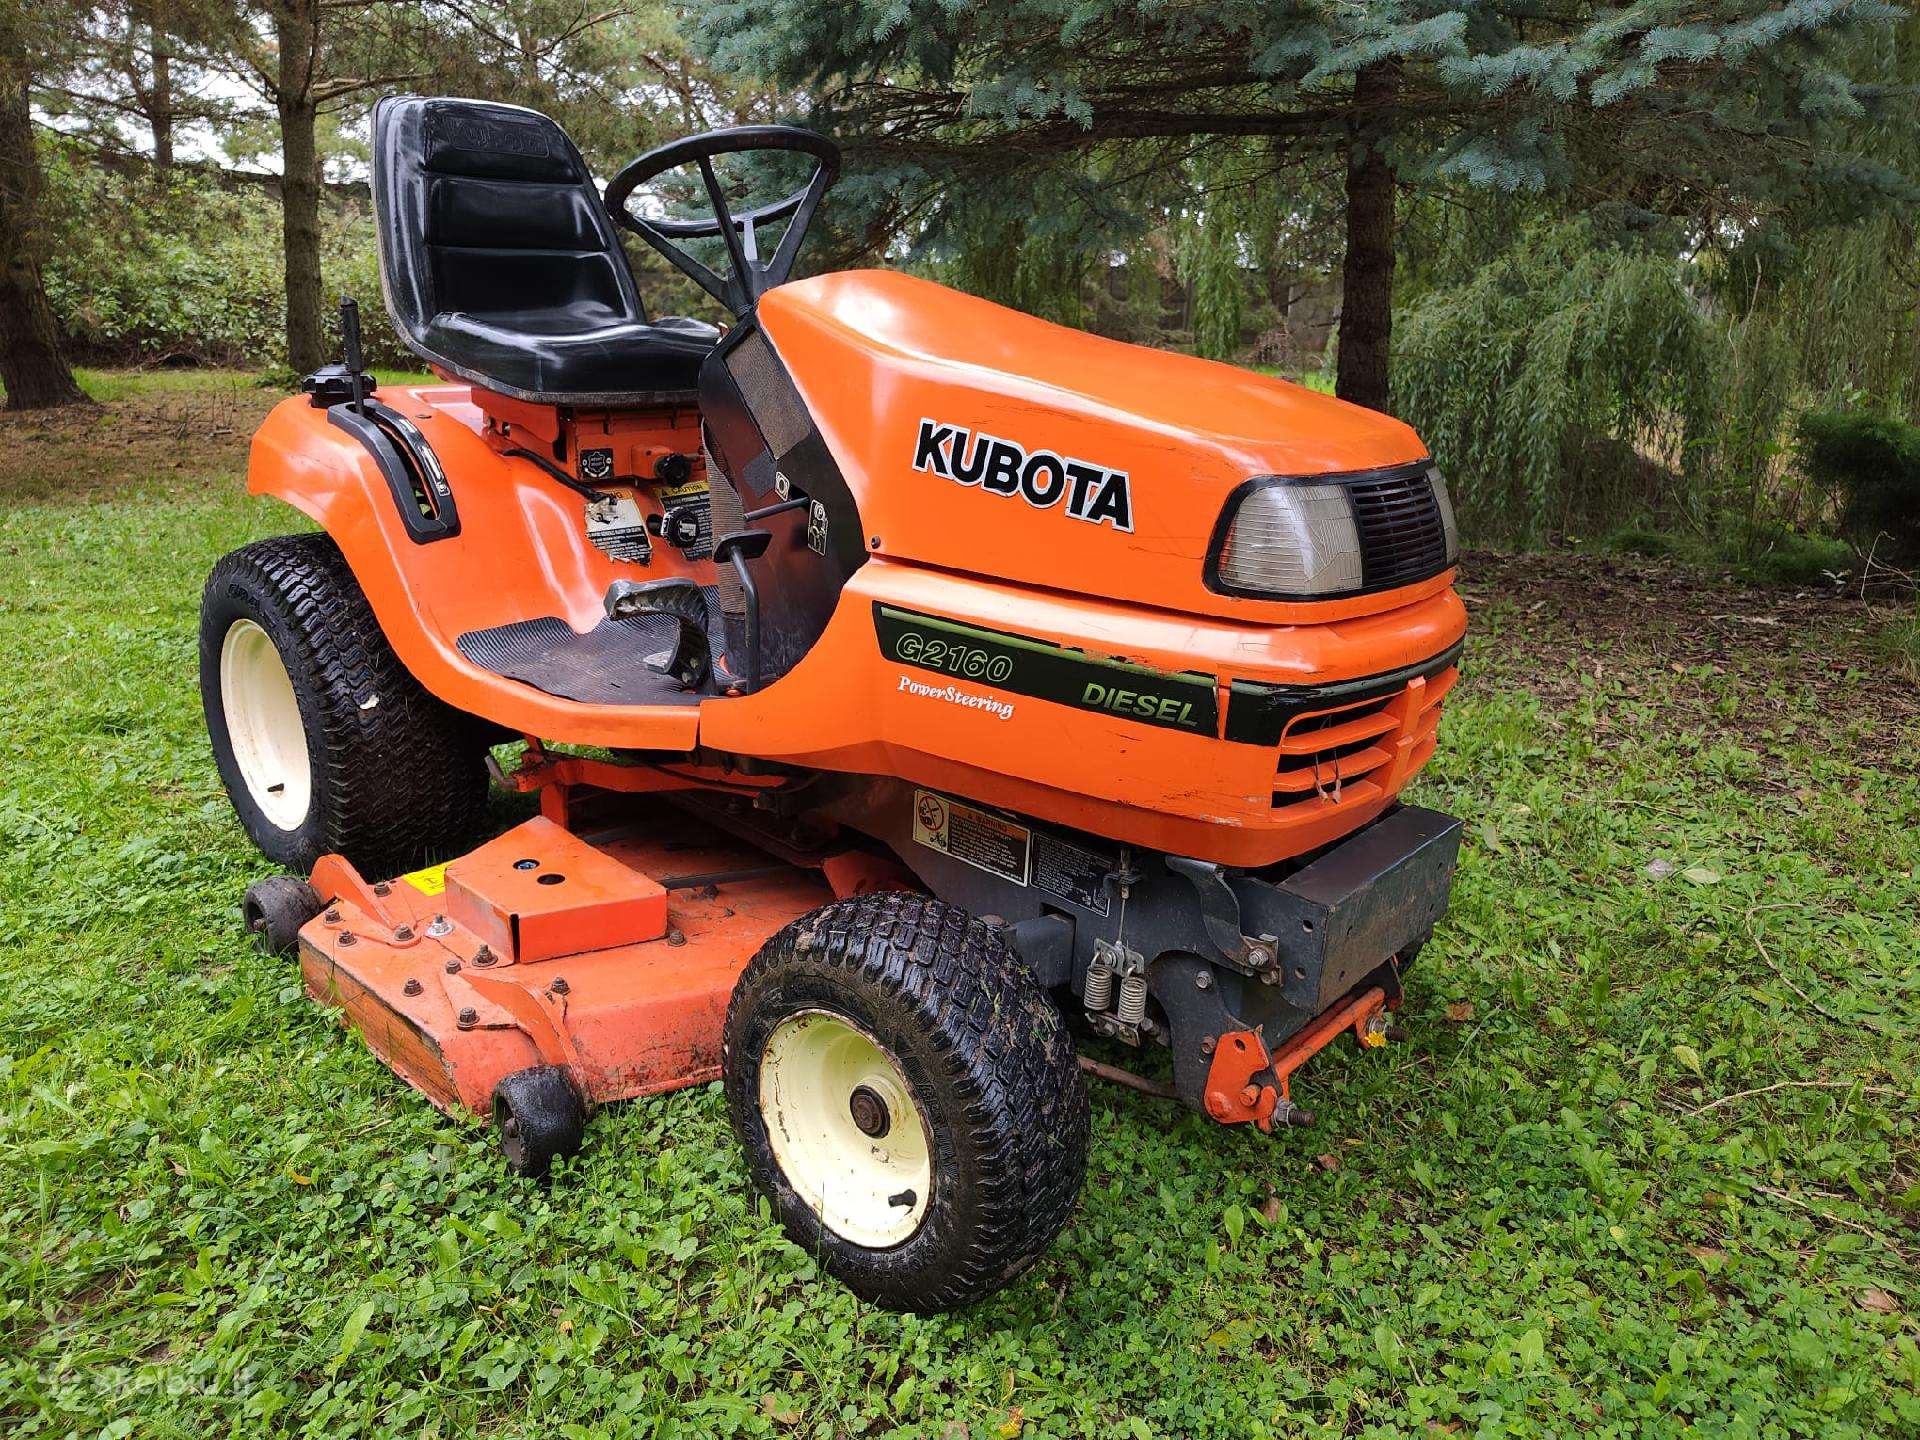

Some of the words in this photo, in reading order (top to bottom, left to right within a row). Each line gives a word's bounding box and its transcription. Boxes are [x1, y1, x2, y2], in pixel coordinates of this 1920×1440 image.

[912, 418, 1134, 533] KUBOTA
[896, 632, 1013, 682] G2160
[897, 675, 1015, 720] PowerSteering
[1082, 682, 1198, 727] DIESEL
